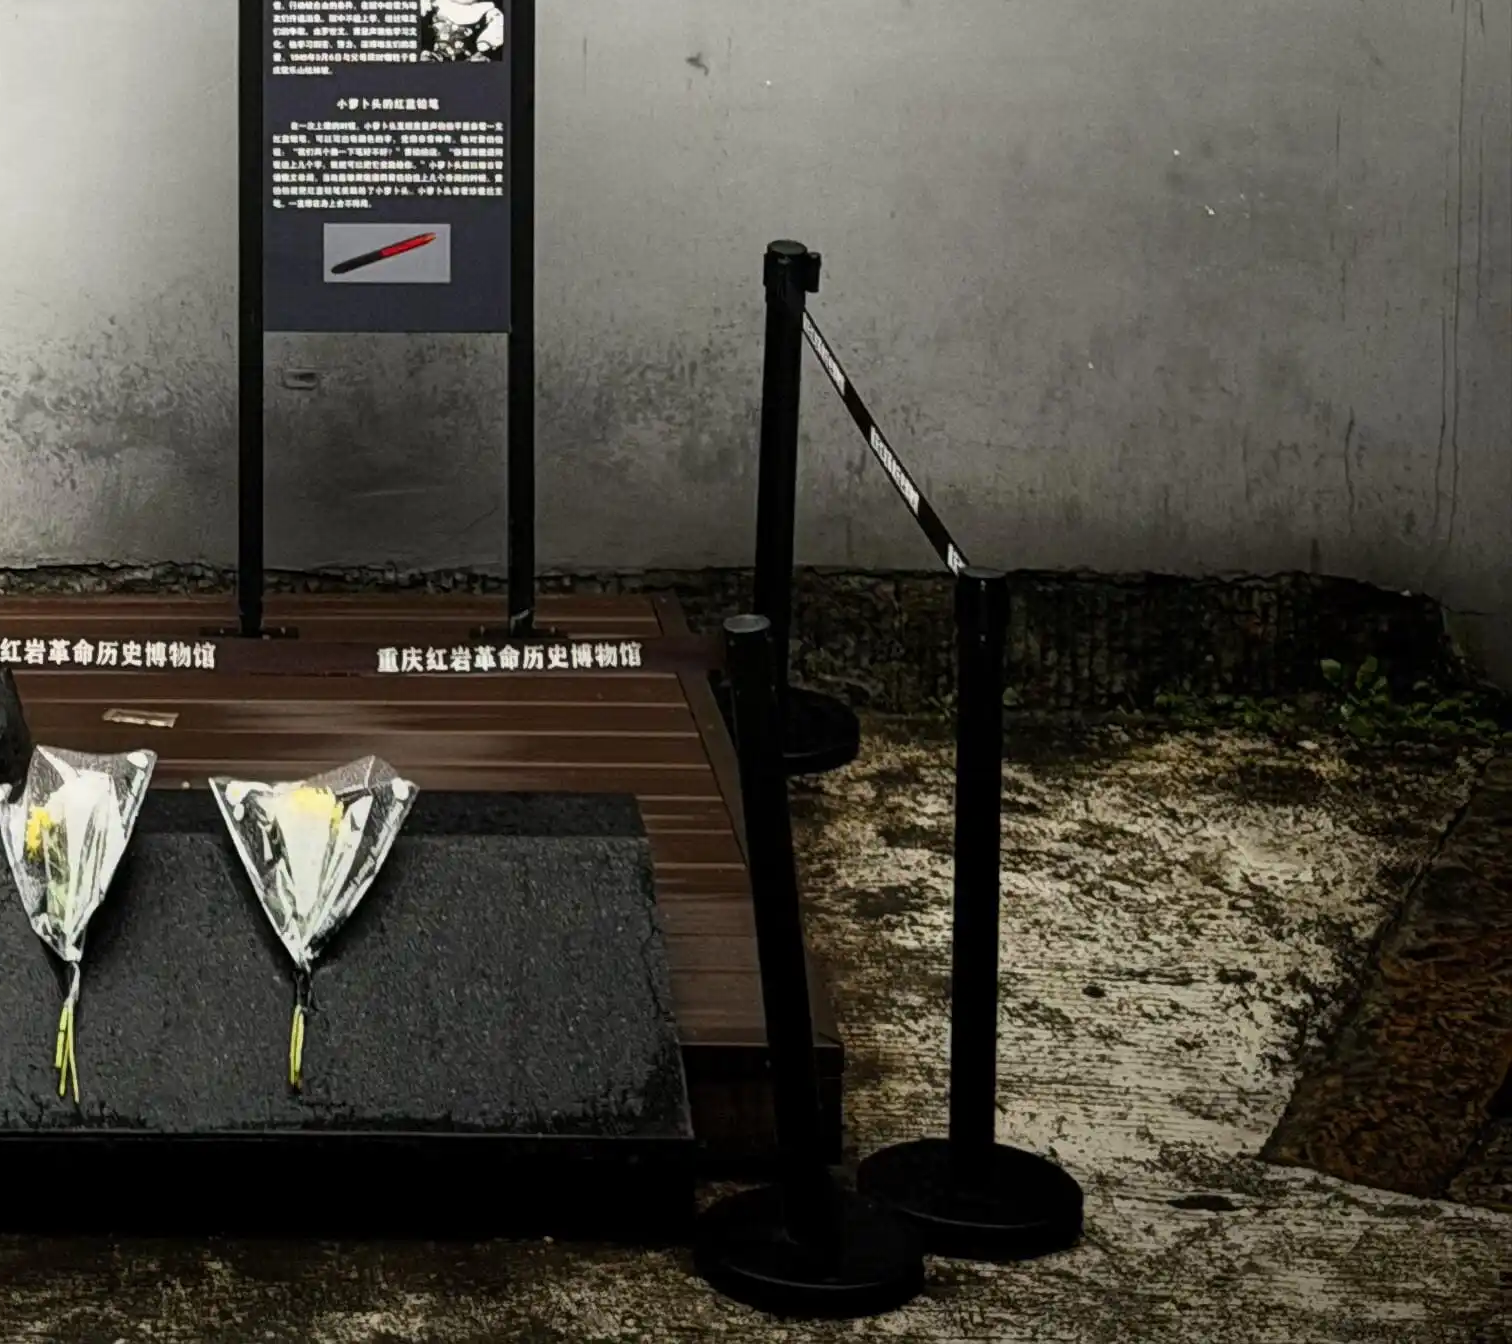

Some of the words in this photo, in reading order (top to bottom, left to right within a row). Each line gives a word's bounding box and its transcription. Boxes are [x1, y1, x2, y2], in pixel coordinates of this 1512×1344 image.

[376, 640, 643, 673] 重庆红岩革命历史博物馆
